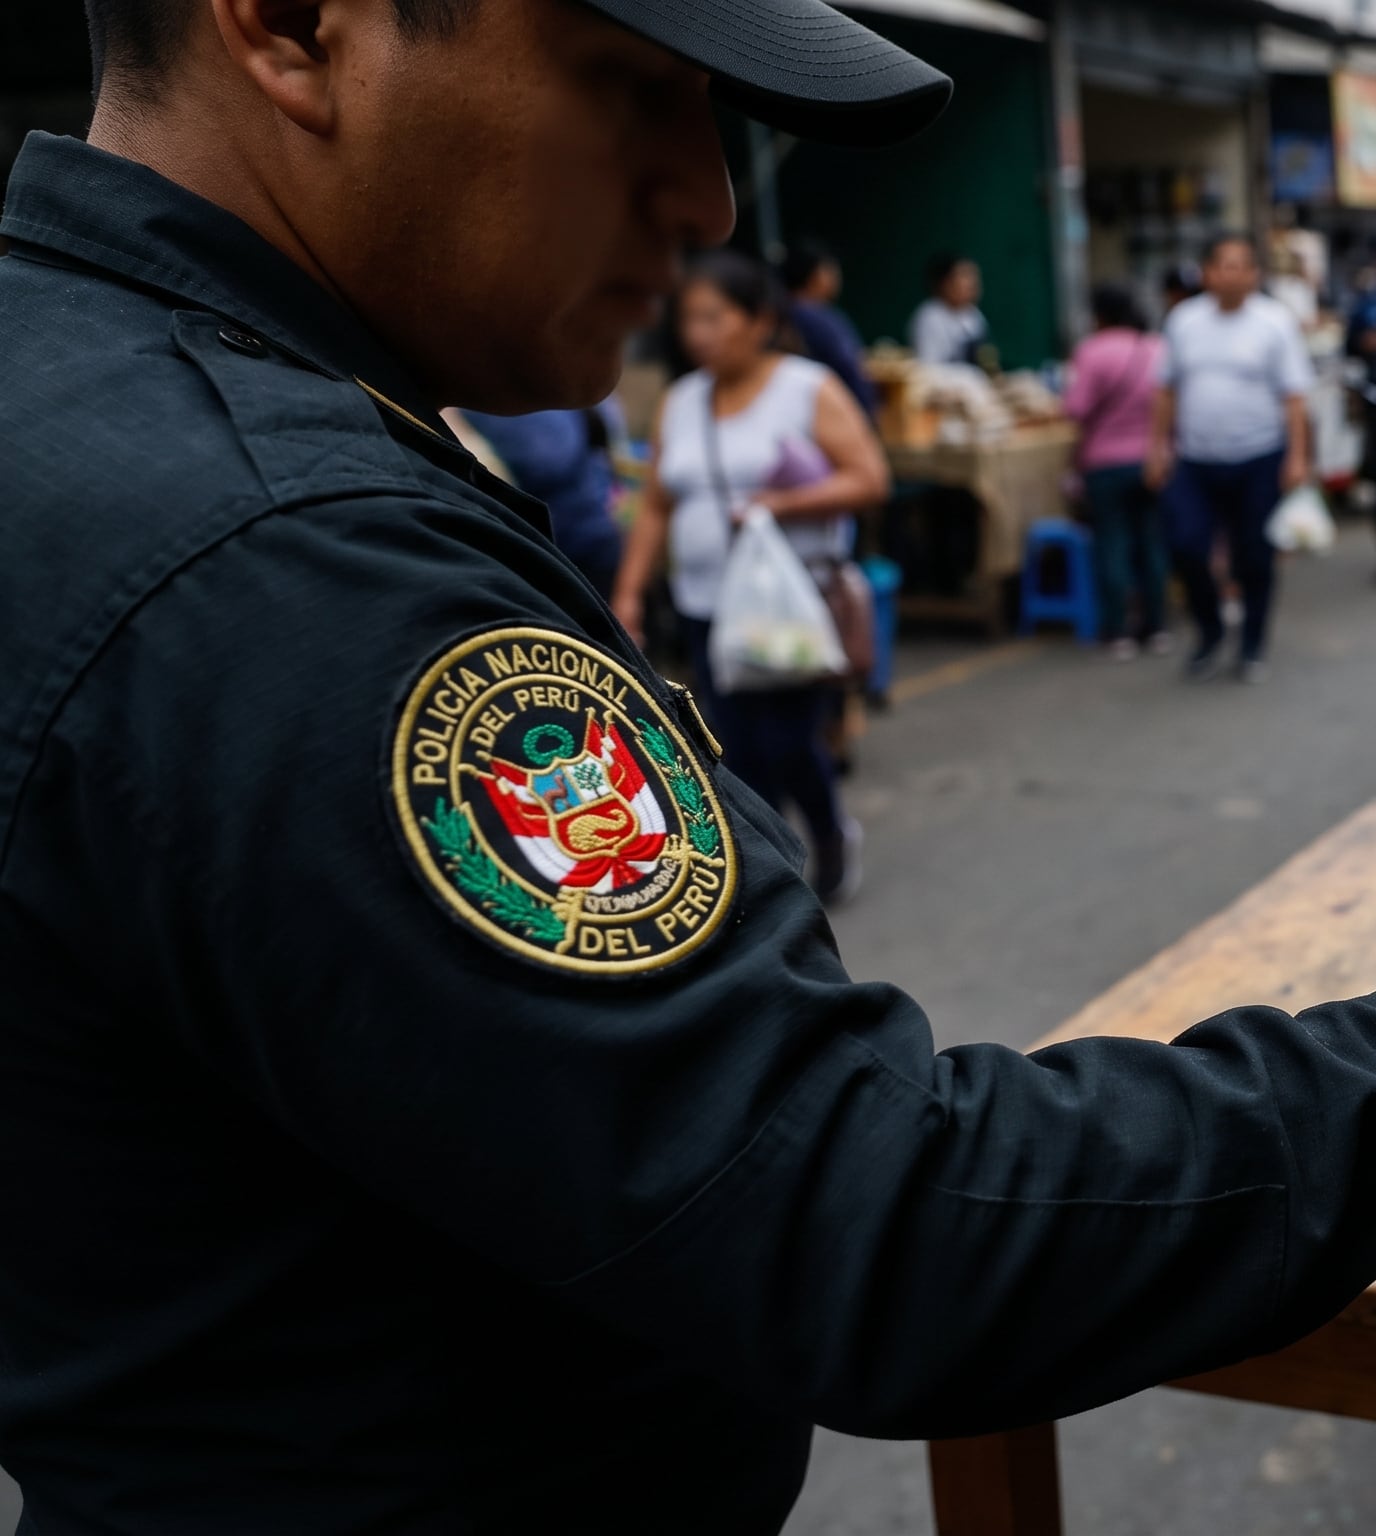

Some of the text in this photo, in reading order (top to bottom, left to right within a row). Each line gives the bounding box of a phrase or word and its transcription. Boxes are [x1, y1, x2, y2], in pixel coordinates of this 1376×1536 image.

[412, 644, 629, 785] POLICÍA NACIONAL
[469, 686, 580, 749] DEL PERÚ
[579, 926, 651, 957] DEL
[654, 861, 720, 943] PERÚ
